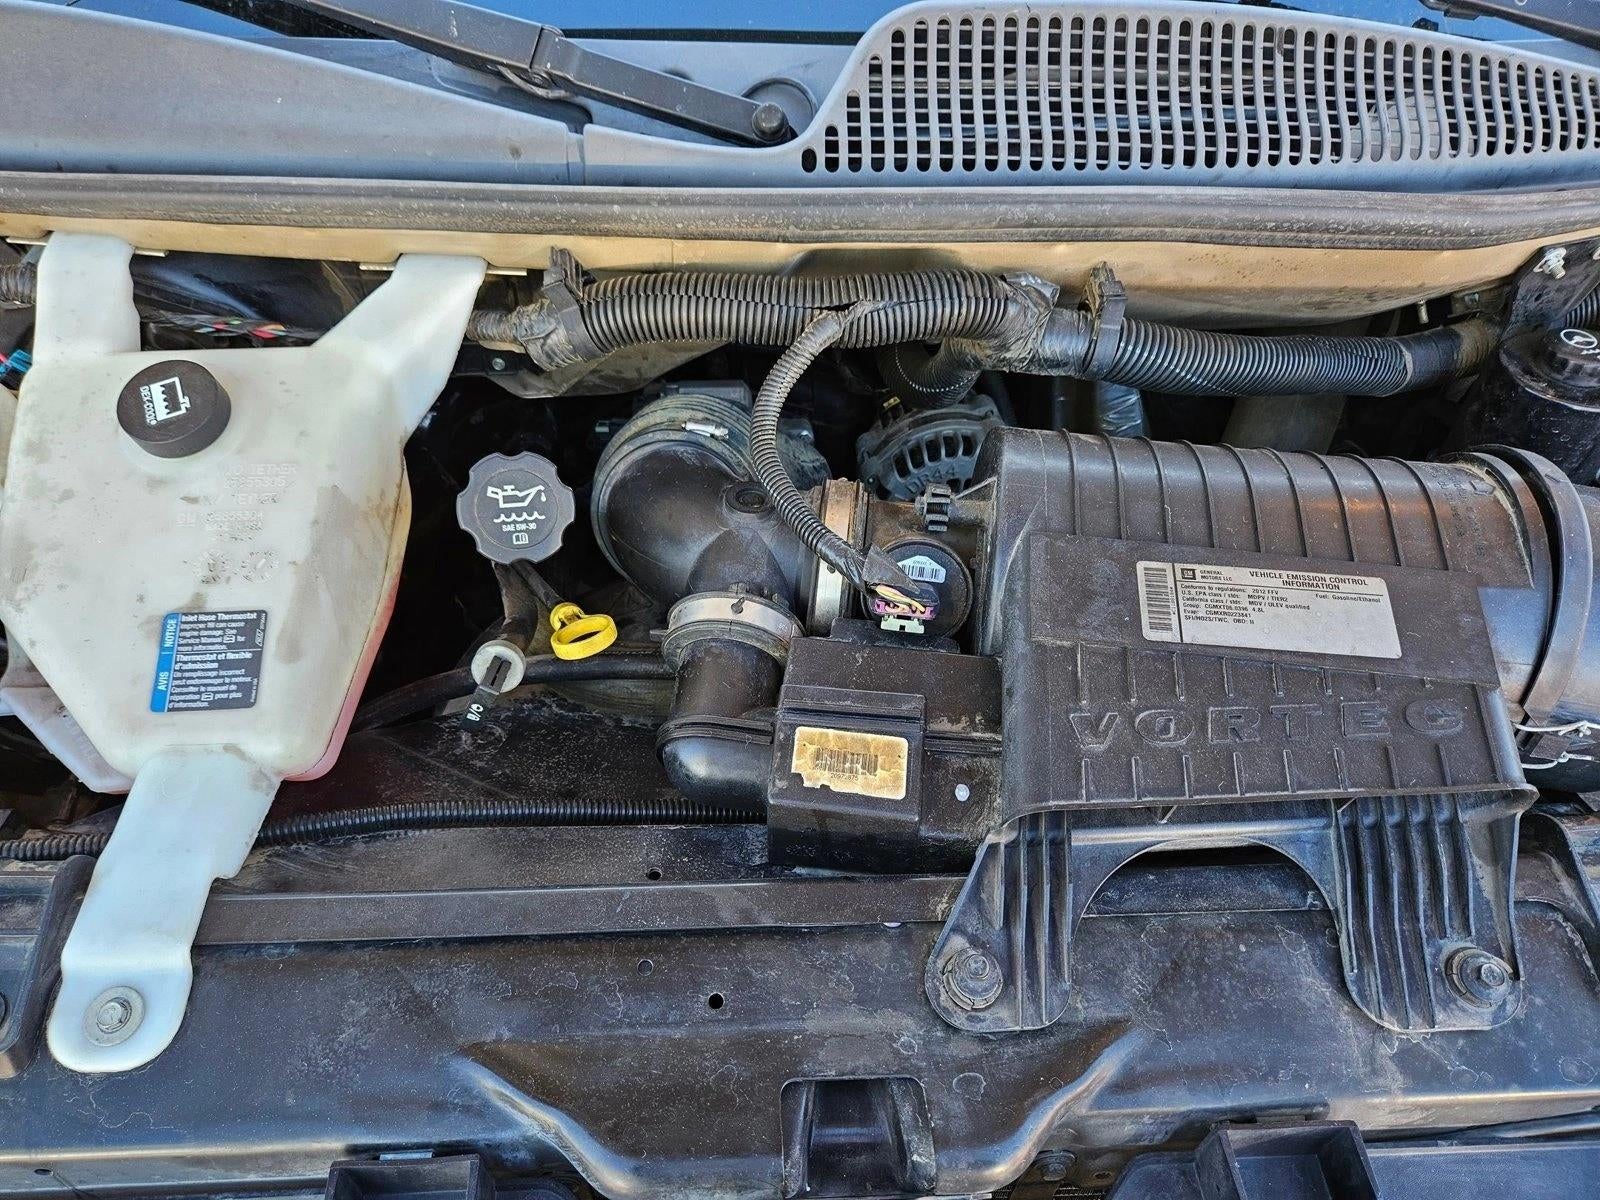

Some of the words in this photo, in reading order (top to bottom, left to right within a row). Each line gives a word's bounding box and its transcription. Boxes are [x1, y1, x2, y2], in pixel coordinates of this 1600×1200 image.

[502, 524, 515, 532] SAE
[516, 522, 537, 531] 5W-30
[1249, 570, 1284, 580] VEHICLE
[1286, 573, 1327, 583] EMISSION
[1329, 576, 1369, 586] CONTROL
[1181, 583, 1206, 591] Conforms
[1282, 579, 1341, 591] INFORMATION
[1332, 594, 1382, 603] Gasoline/Ethanol
[181, 614, 198, 622] Inlet
[198, 613, 217, 622] Hose
[217, 612, 258, 621] Thermostat
[164, 618, 177, 648] NOTICE
[176, 653, 217, 662] Thermostat
[157, 671, 169, 691] AVIS
[1069, 700, 1464, 750] VORTEC
